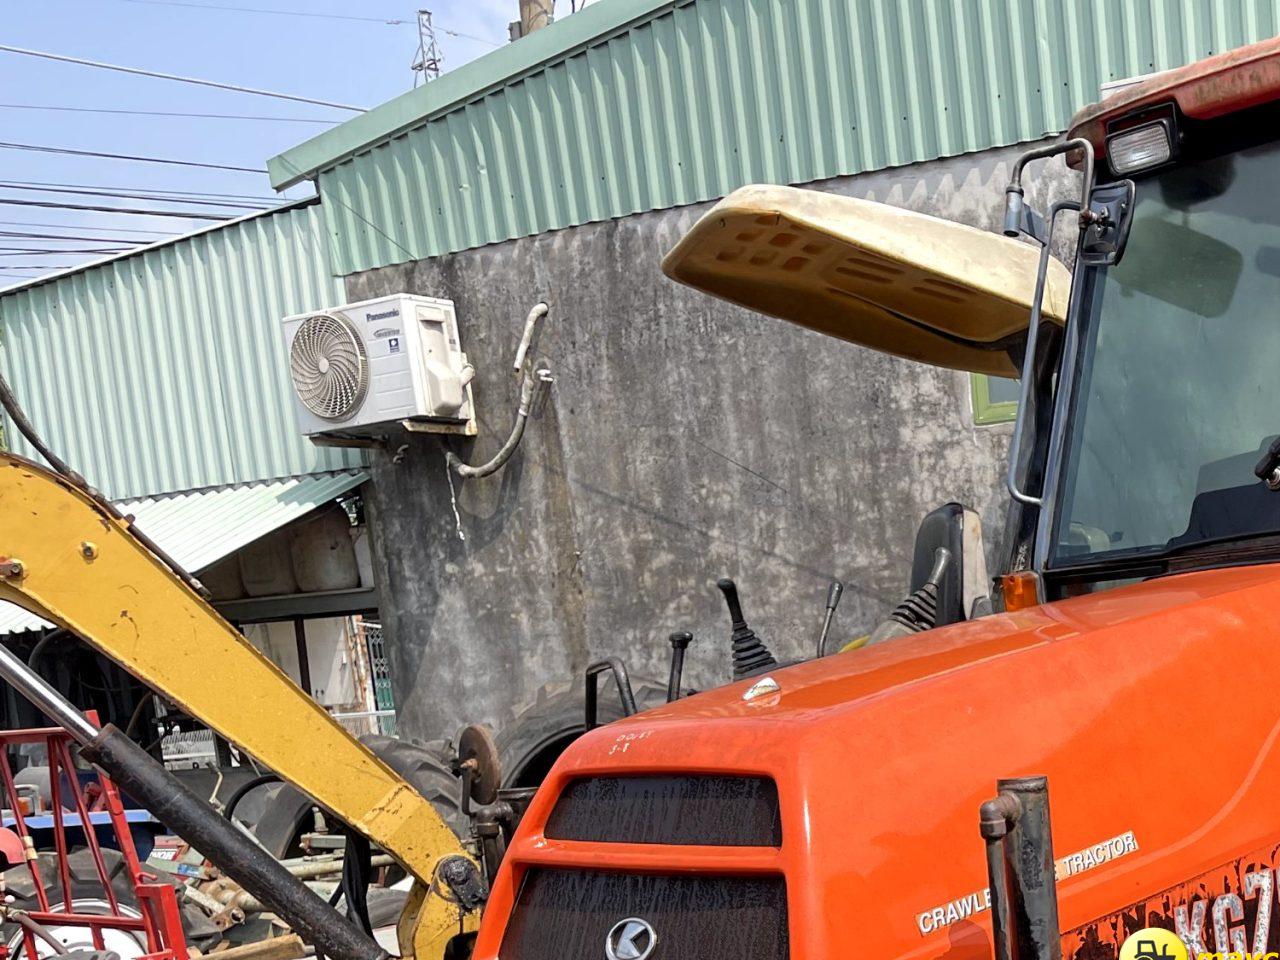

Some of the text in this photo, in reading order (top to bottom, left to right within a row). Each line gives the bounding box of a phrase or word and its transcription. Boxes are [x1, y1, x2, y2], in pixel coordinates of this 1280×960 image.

[366, 309, 399, 321] Panasonic
[918, 887, 992, 934] CRAWLE
[1063, 833, 1137, 876] TRACTOR
